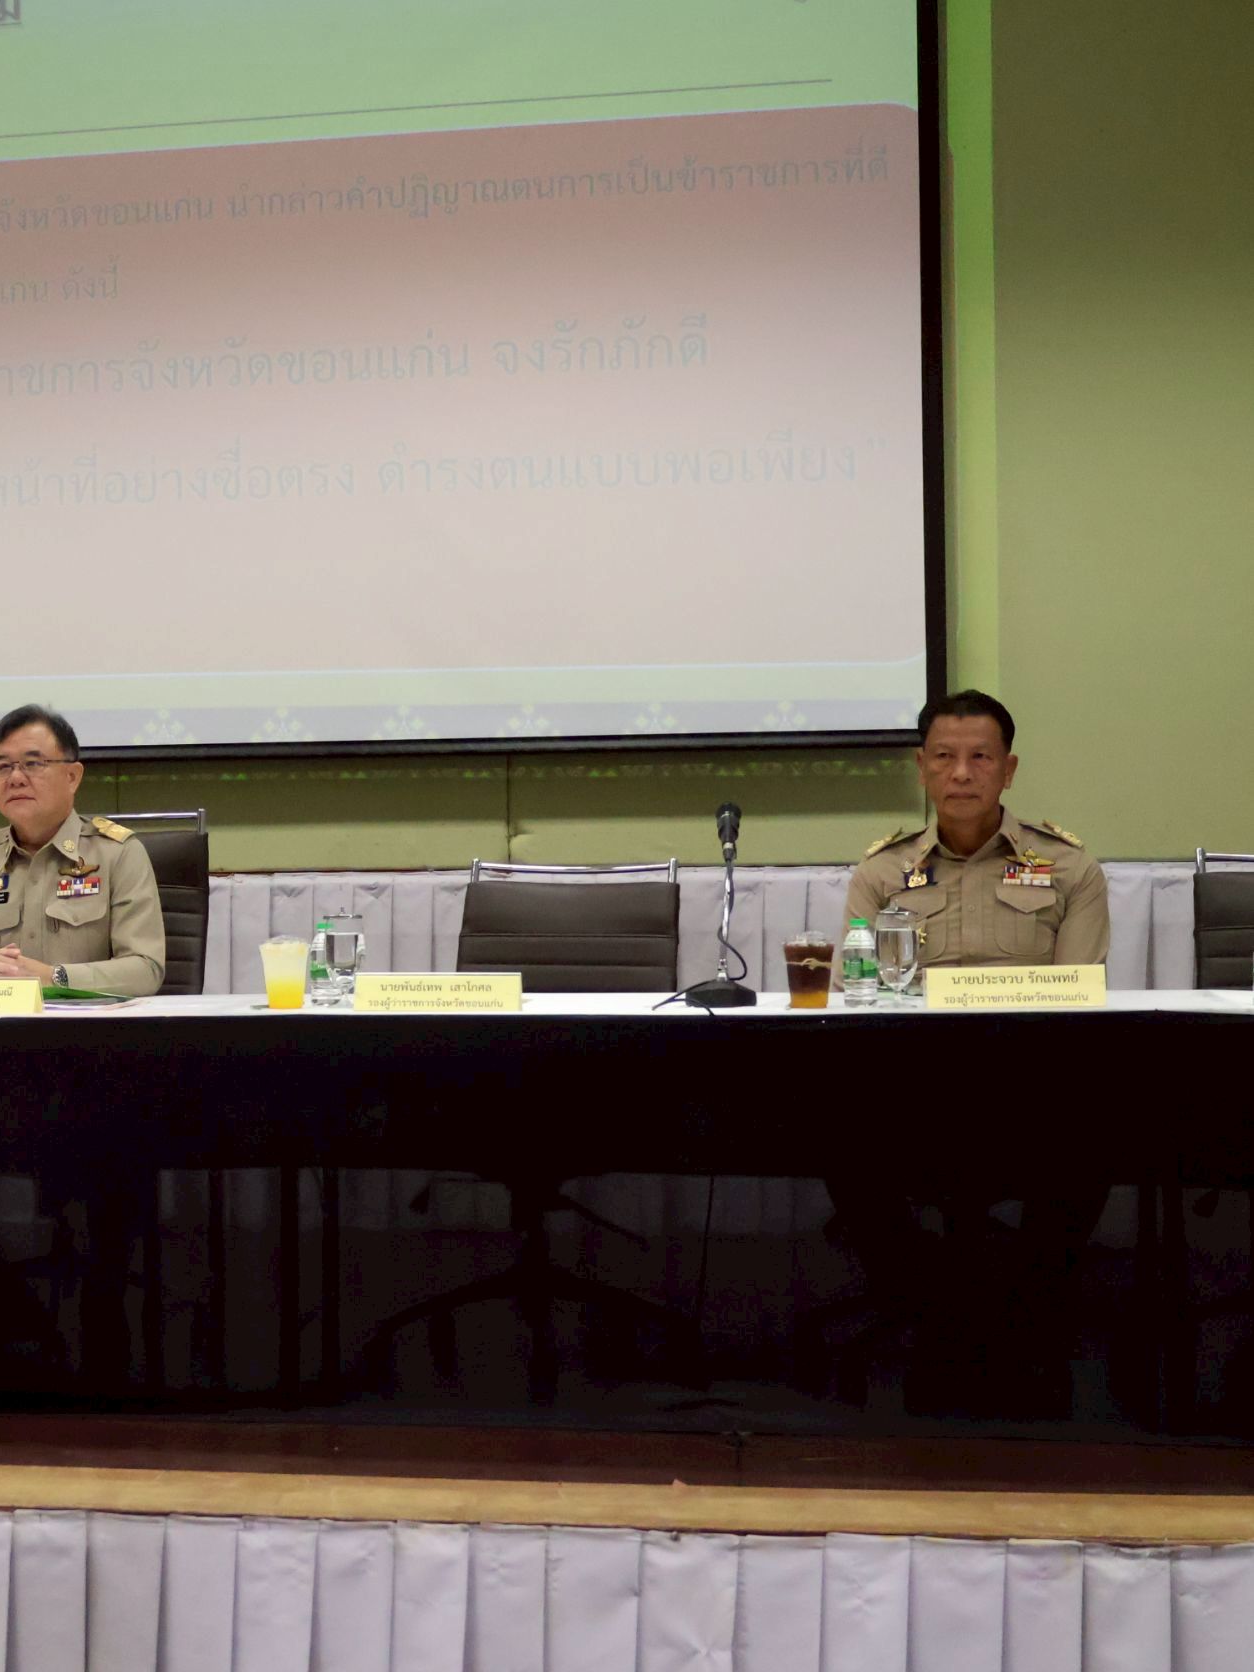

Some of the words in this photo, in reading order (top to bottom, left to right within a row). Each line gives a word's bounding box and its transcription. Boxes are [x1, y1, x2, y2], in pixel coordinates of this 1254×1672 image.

[491, 312, 708, 376] จงรักภักดี
[951, 973, 1023, 986] นายประจวบ
[1028, 970, 1079, 985] รักแพทย์
[944, 992, 1089, 1007] รองผู้ว่าราชการจังหวัดขอนแก่น
